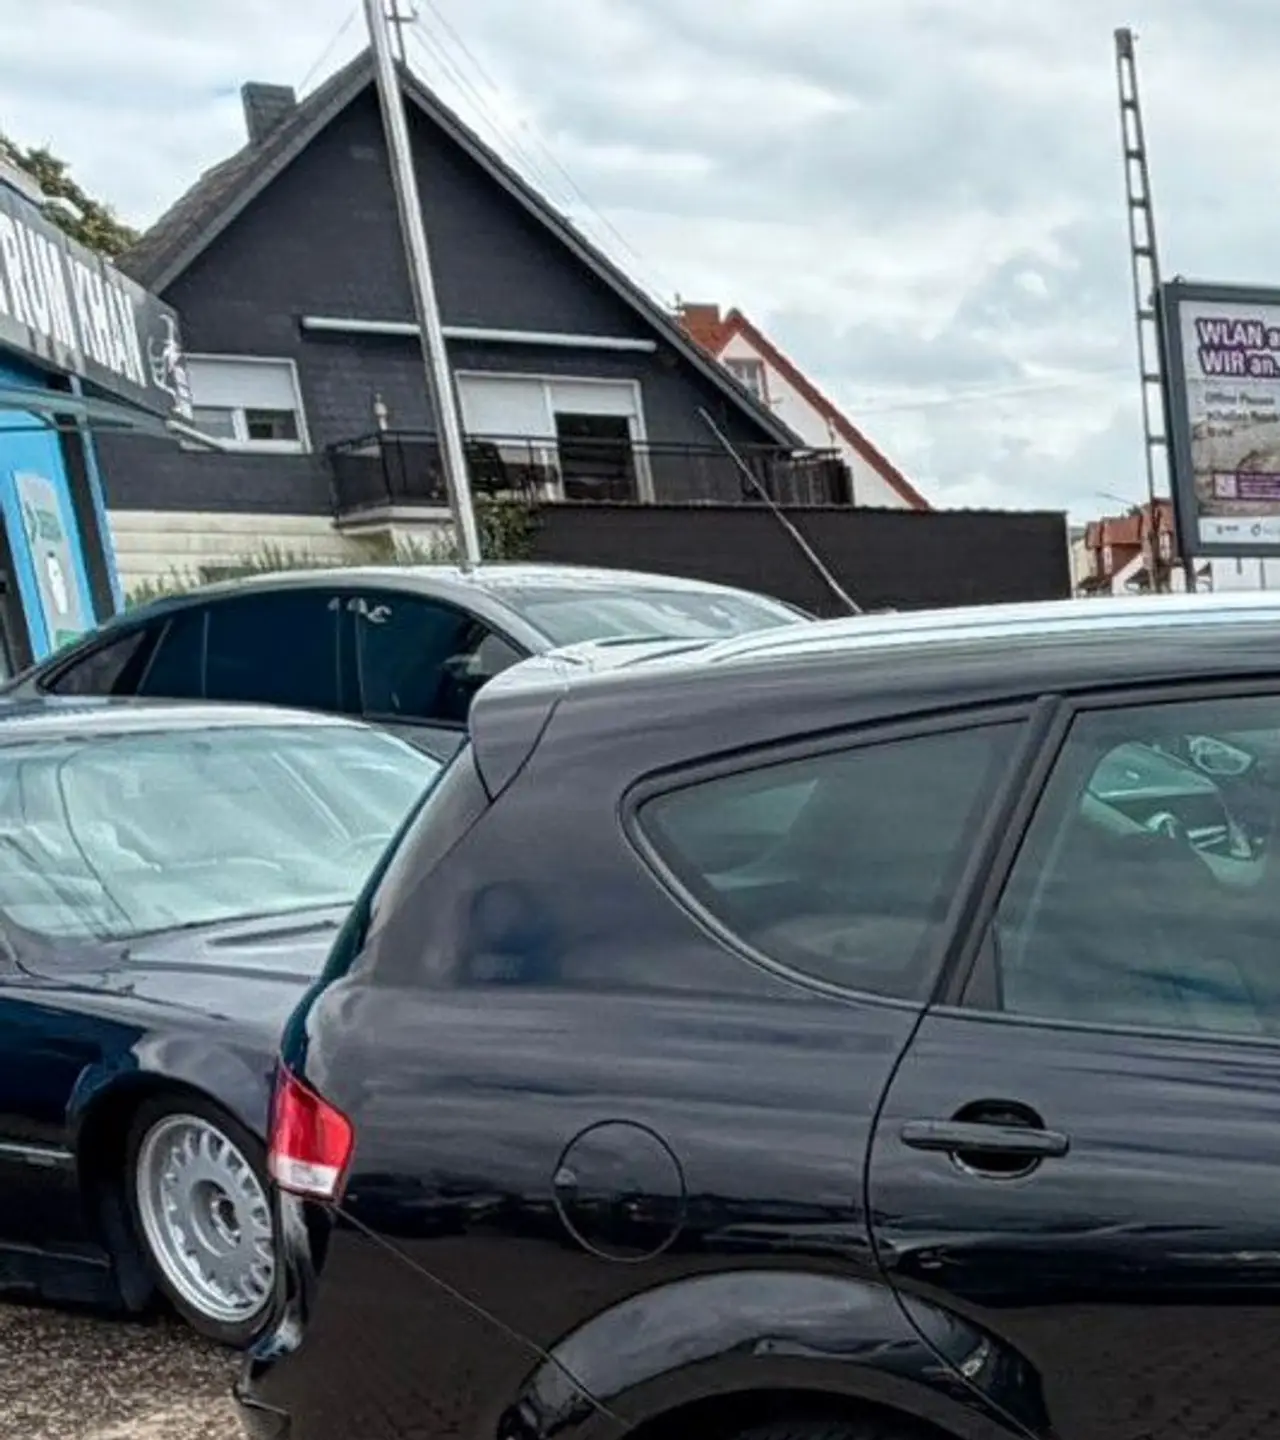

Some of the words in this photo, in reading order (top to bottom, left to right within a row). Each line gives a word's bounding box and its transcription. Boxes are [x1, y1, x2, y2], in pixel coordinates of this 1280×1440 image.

[1198, 319, 1263, 348] WLAN
[1201, 349, 1244, 374] WIR
[1249, 356, 1280, 377] an.
